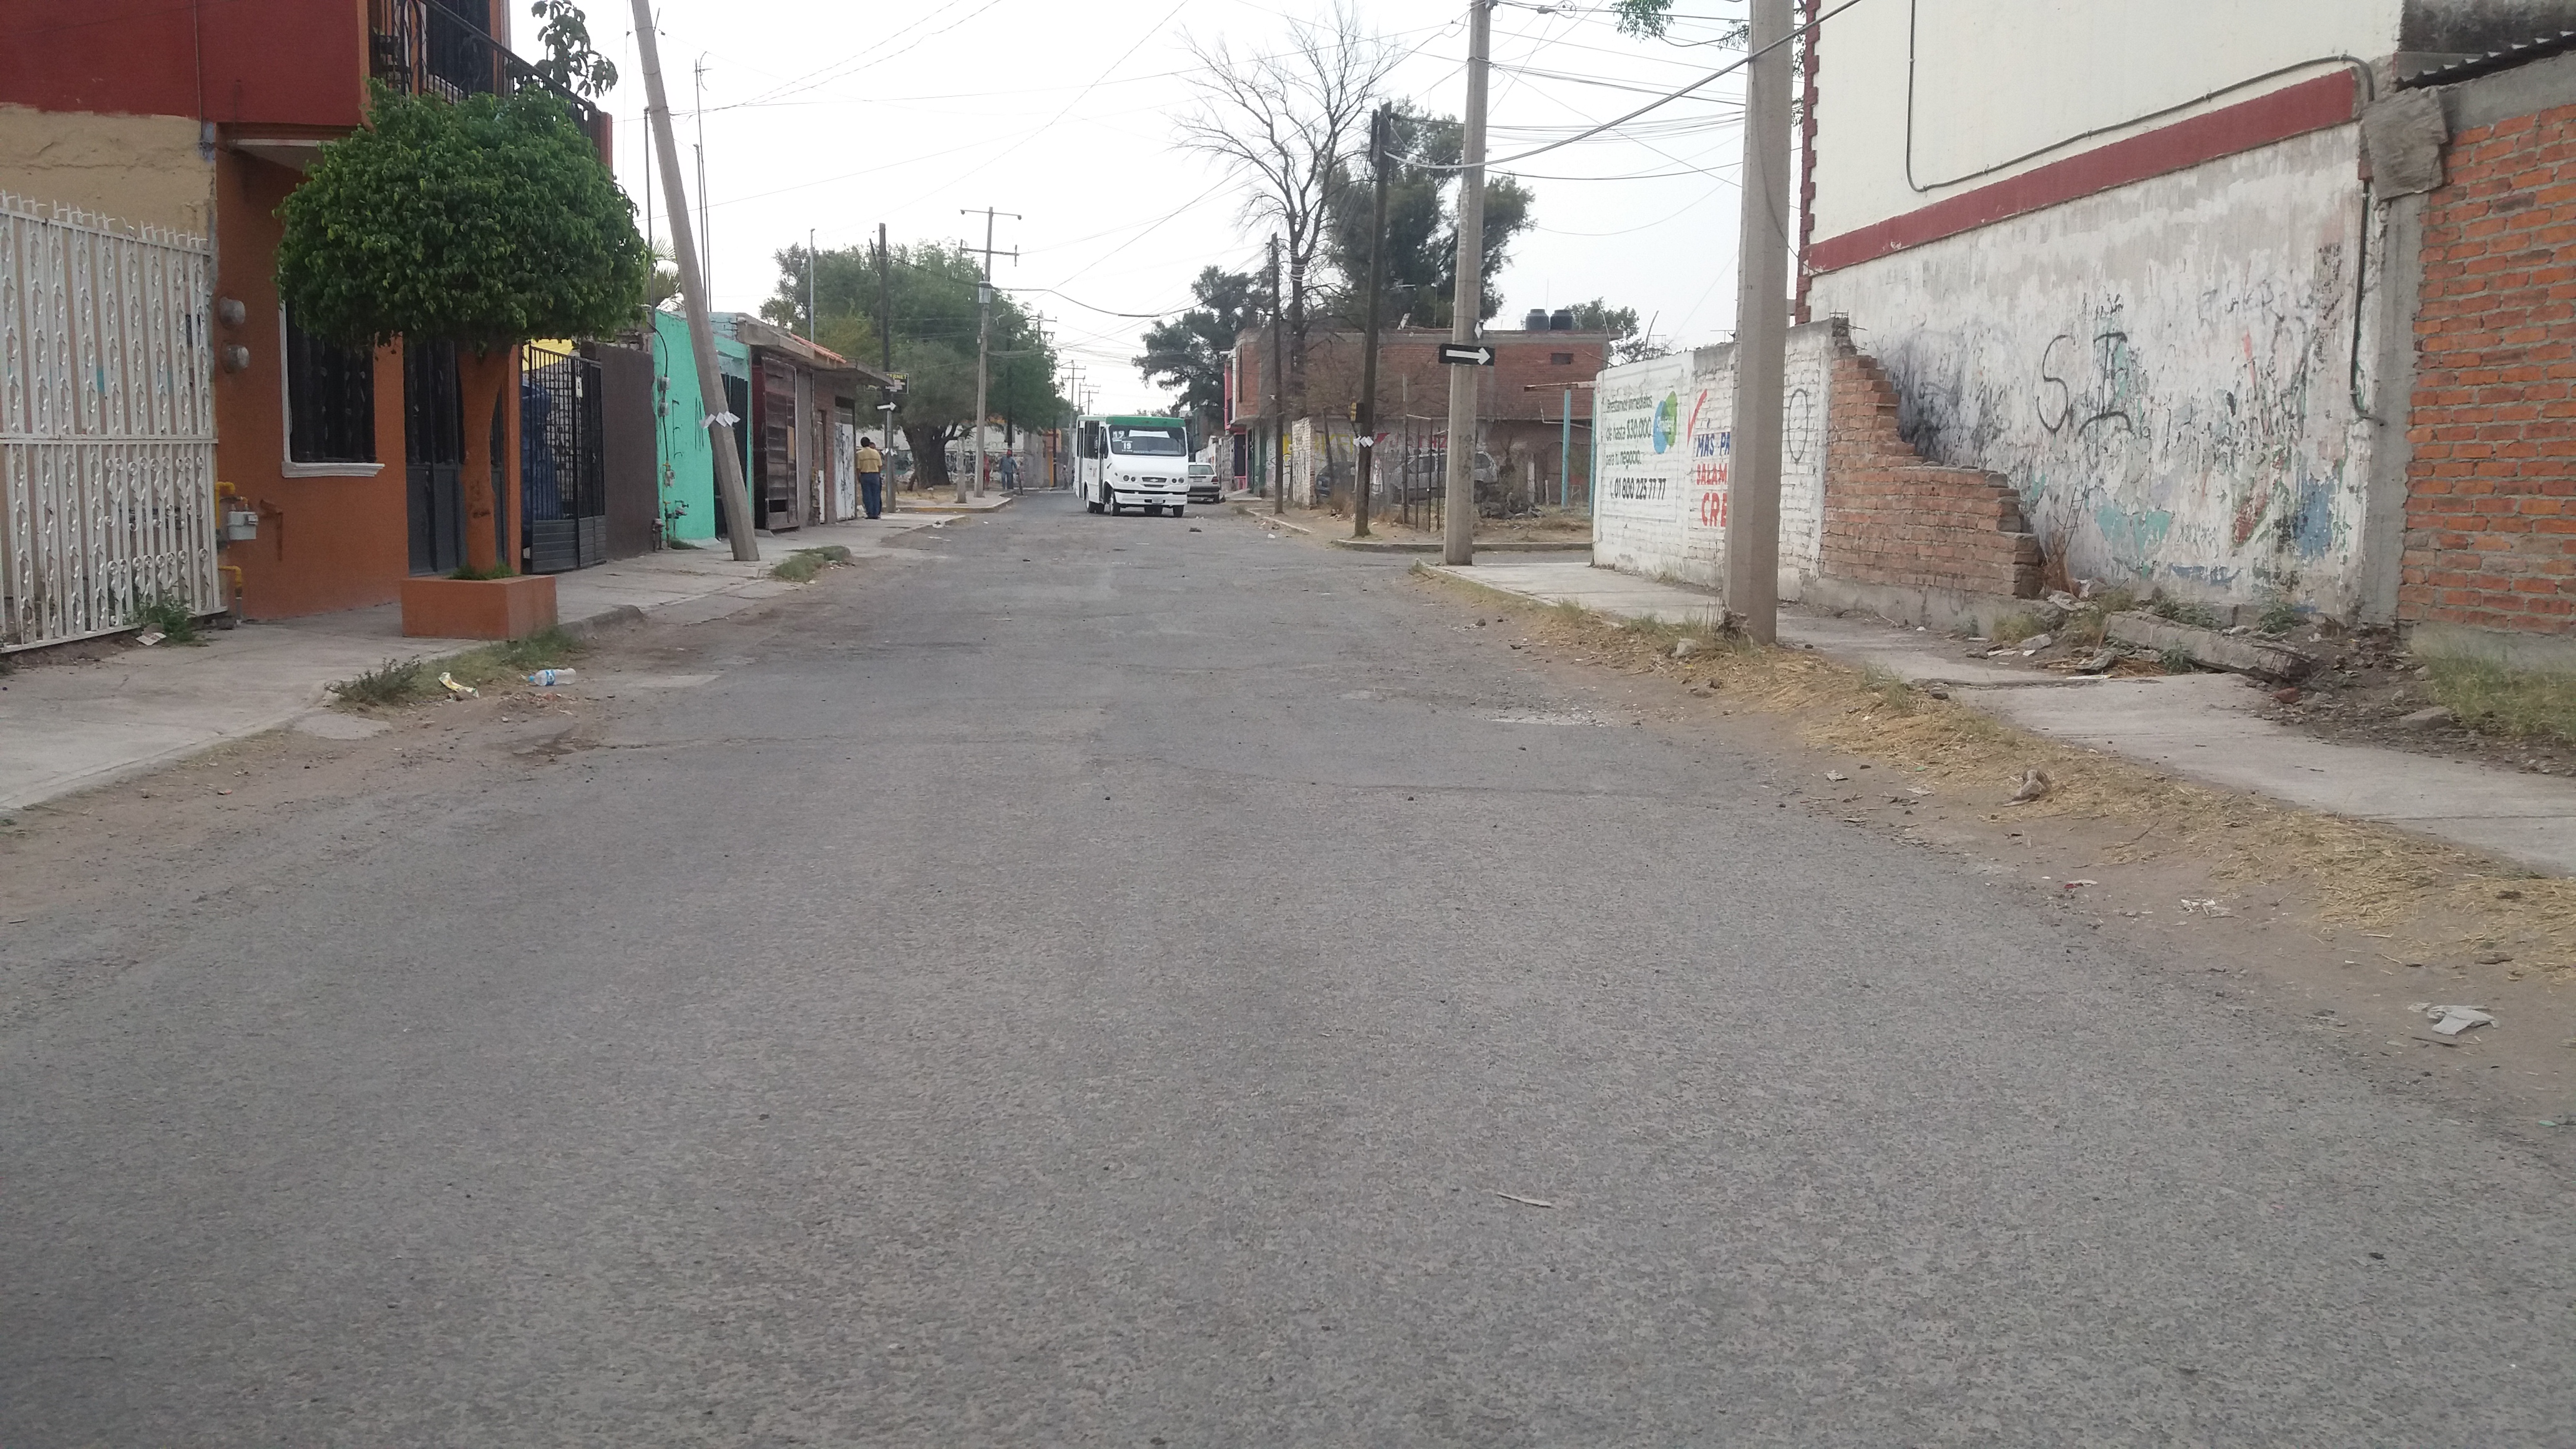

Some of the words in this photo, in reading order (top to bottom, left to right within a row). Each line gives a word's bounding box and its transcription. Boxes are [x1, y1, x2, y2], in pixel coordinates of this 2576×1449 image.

[1613, 424, 1626, 440] hasta
[1614, 477, 1621, 499] 01
[1622, 477, 1634, 499] 800
[1636, 477, 1647, 500] 225
[1648, 477, 1657, 500] 77
[1658, 477, 1666, 500] 77
